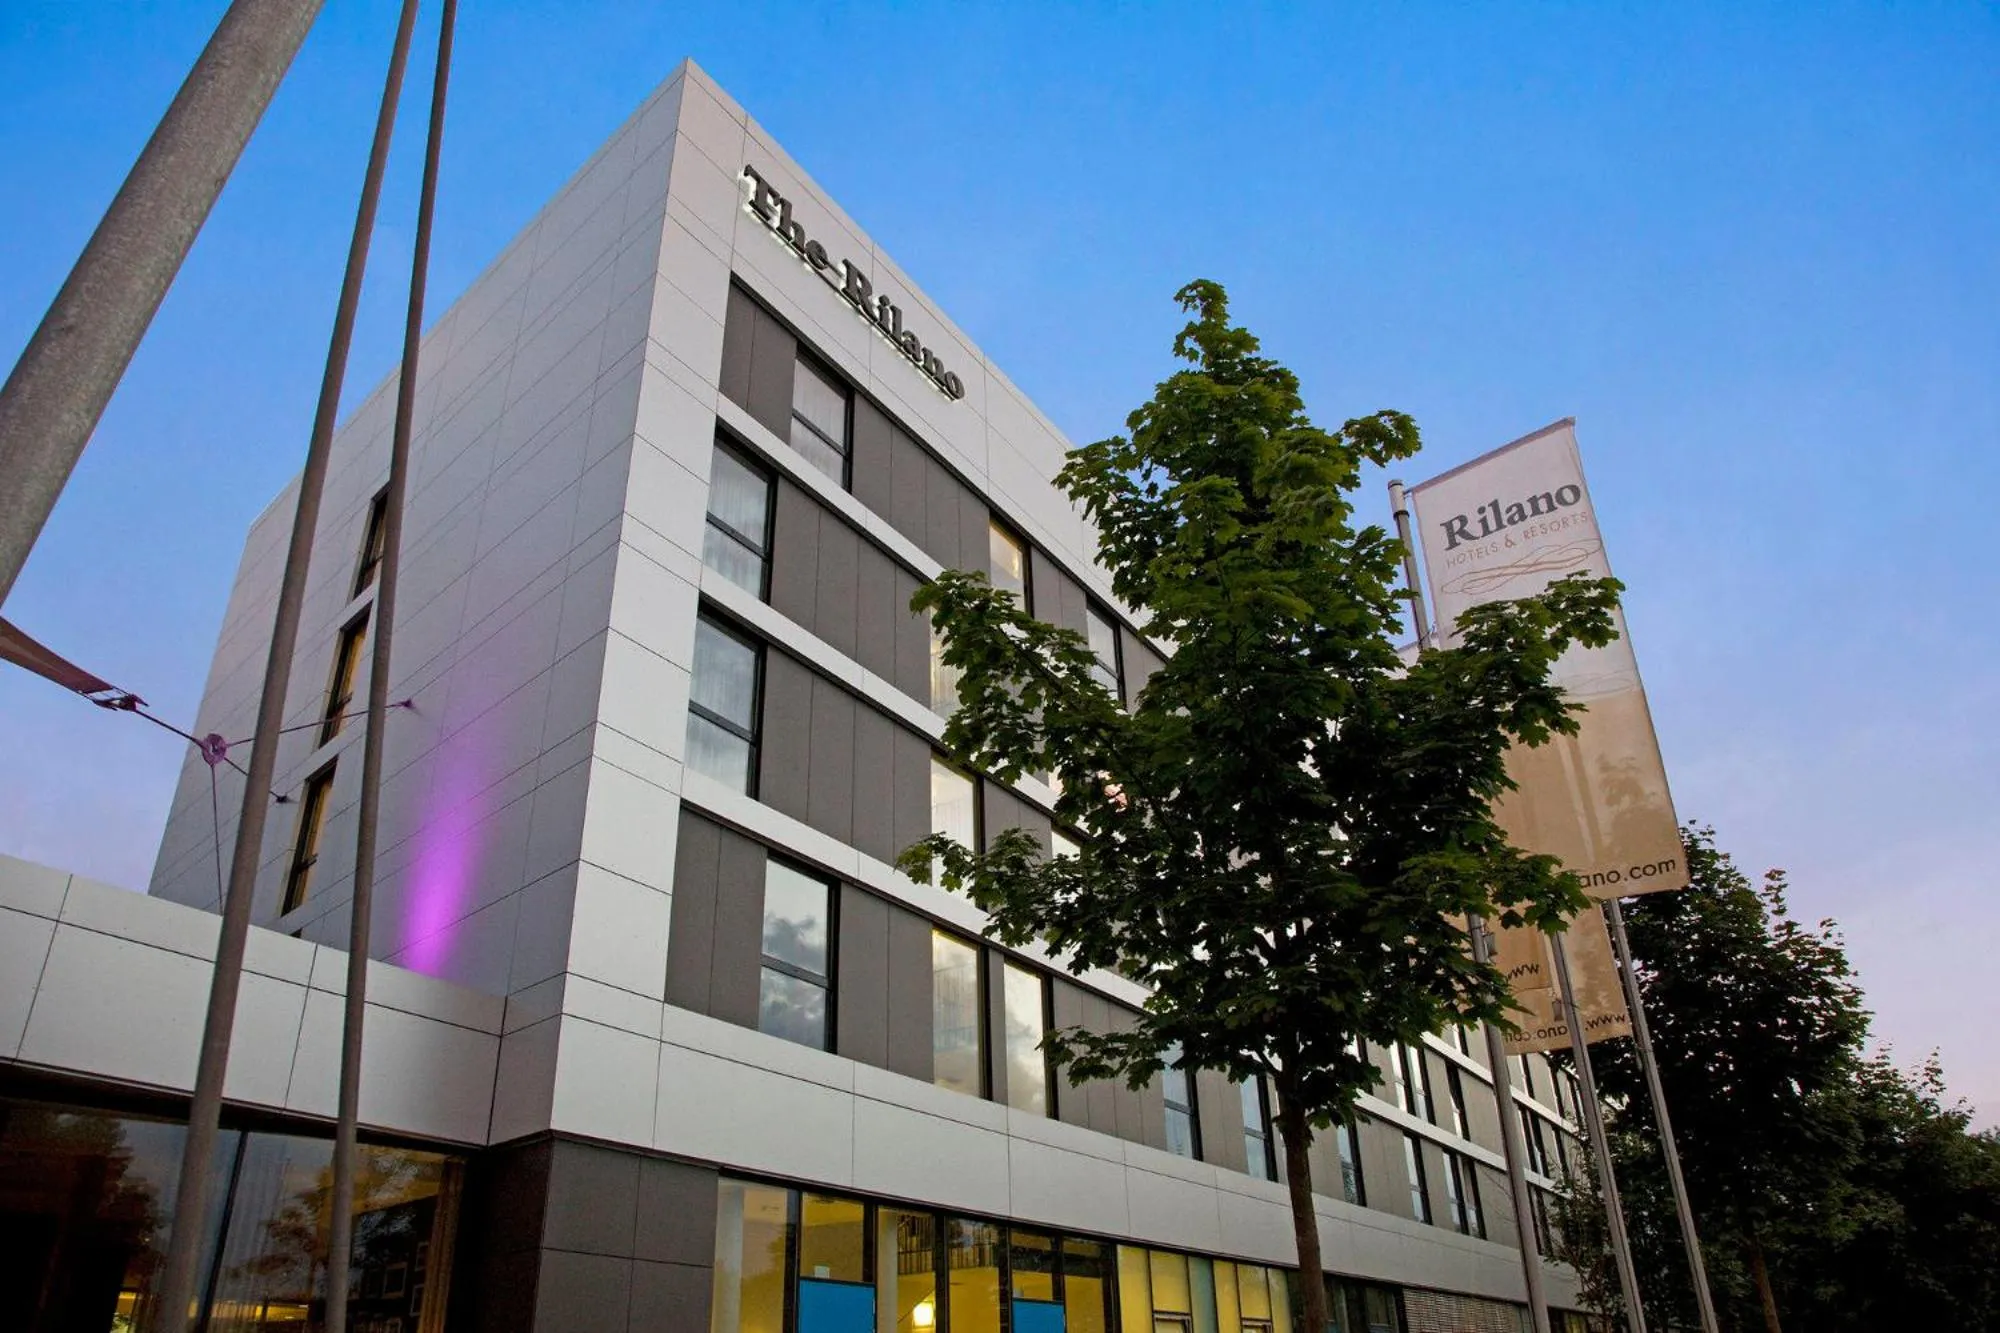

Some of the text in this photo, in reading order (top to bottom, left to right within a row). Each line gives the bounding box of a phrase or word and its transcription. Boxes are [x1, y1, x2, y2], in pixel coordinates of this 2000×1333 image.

[744, 164, 965, 400] The Rilano
[1440, 483, 1581, 551] Rilano
[1446, 511, 1588, 569] HOTELS & RESORTS
[1579, 858, 1676, 889] ano.com
